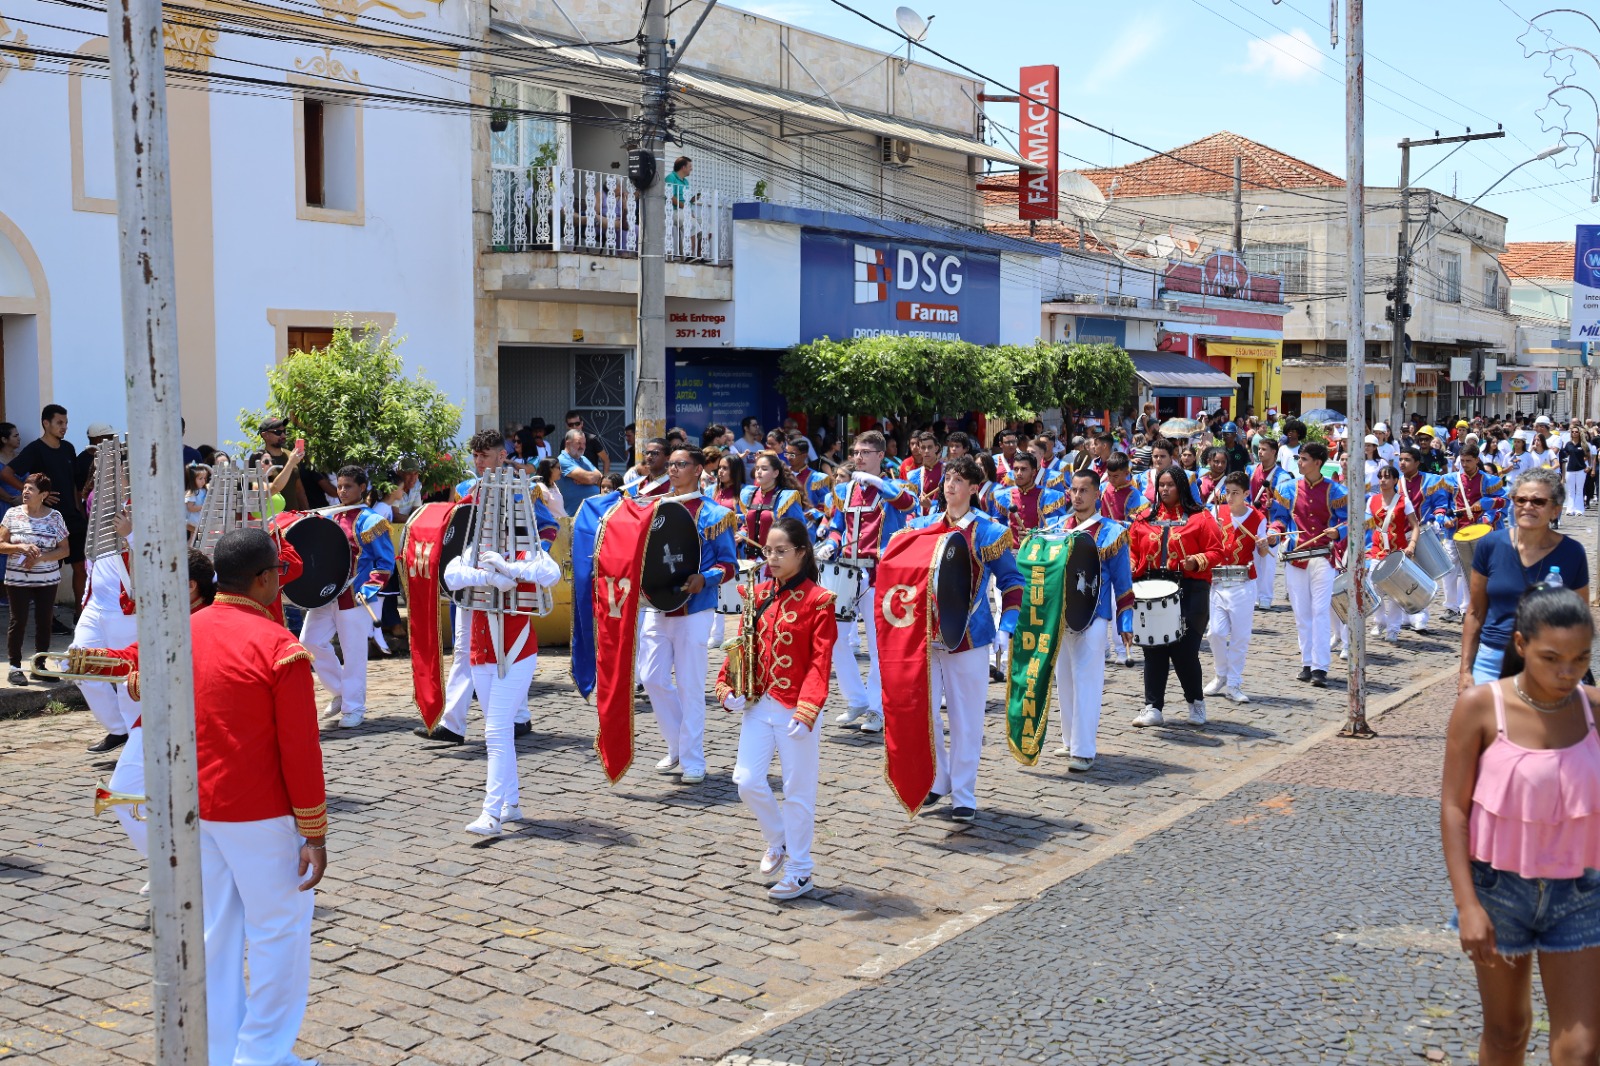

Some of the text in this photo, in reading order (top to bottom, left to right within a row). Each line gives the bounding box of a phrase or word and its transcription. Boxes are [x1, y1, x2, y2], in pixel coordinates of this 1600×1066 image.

[897, 249, 963, 295] DSG
[670, 313, 726, 324] Disk Entrega
[911, 303, 959, 323] Farma
[675, 329, 696, 338] 3571
[701, 329, 721, 338] 2181
[681, 403, 703, 412] FARMA
[882, 584, 918, 628] G
[1022, 631, 1051, 653] DE
